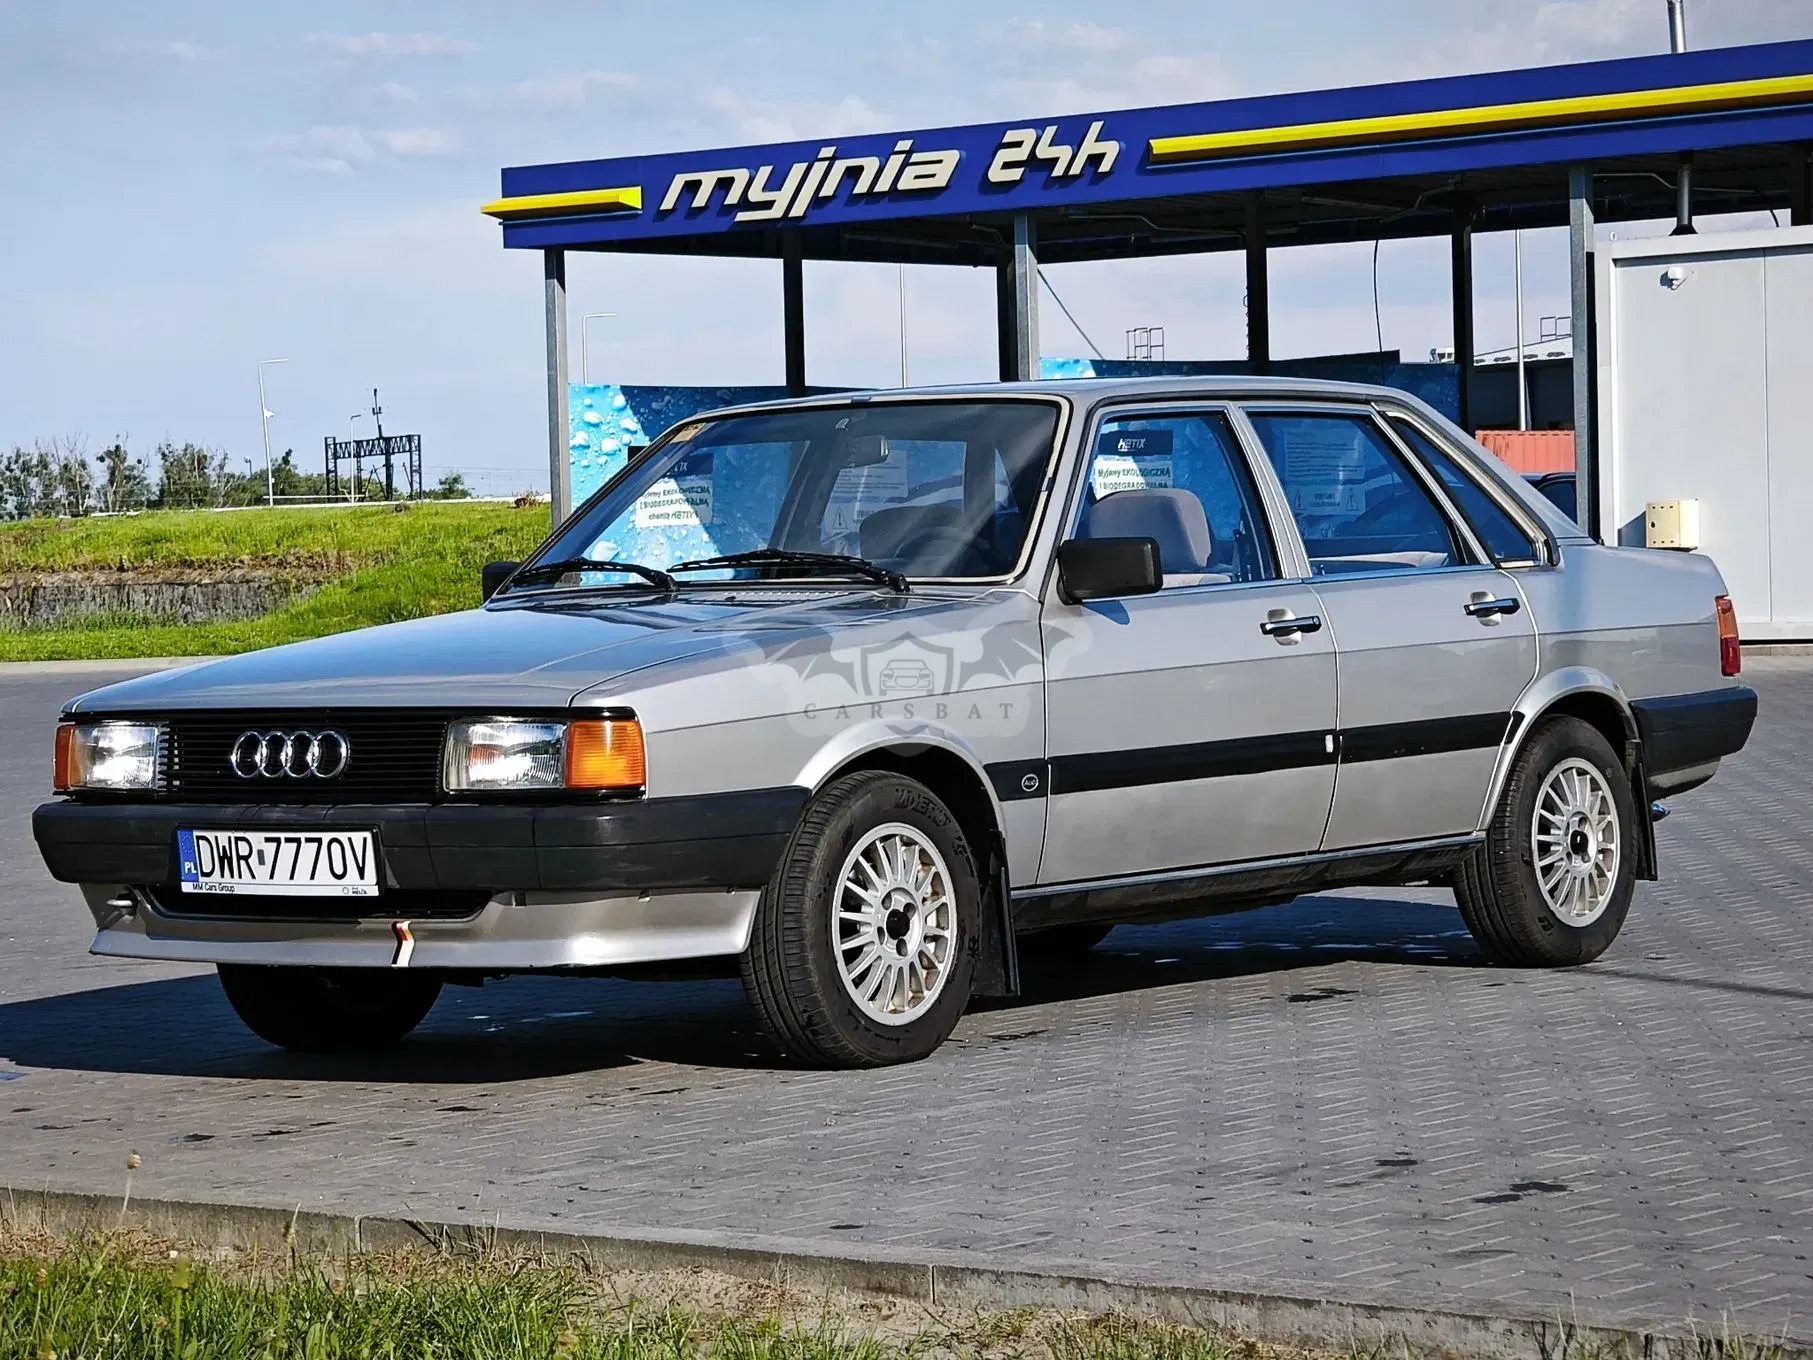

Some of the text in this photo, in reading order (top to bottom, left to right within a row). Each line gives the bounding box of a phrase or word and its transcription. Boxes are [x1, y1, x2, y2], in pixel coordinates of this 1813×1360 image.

[659, 121, 1121, 223] myjnia 24h
[184, 861, 197, 874] PL
[195, 835, 367, 881] DWR 7770V
[204, 883, 217, 891] Cars
[218, 883, 235, 893] Group
